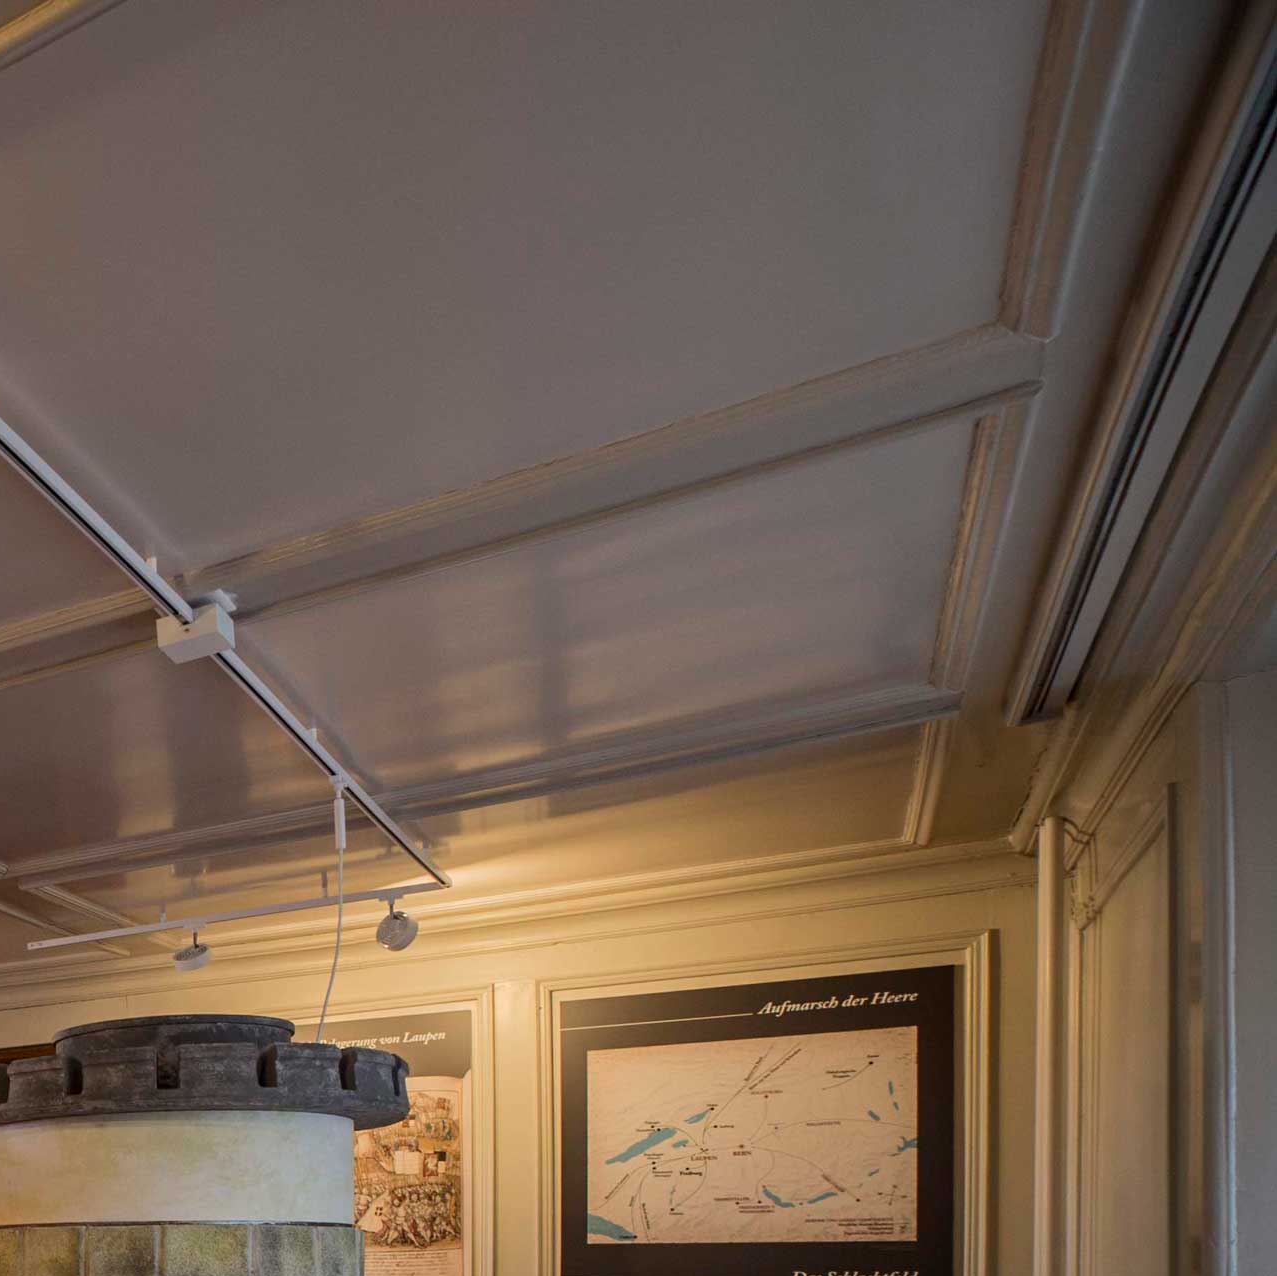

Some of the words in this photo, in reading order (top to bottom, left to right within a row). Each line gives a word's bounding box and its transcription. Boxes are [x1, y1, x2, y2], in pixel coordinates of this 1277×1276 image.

[758, 996, 839, 1017] Aufmarsch
[841, 994, 869, 1007] der
[870, 991, 919, 1005] Heere
[379, 1036, 400, 1044] von
[402, 1031, 446, 1045] Laupen
